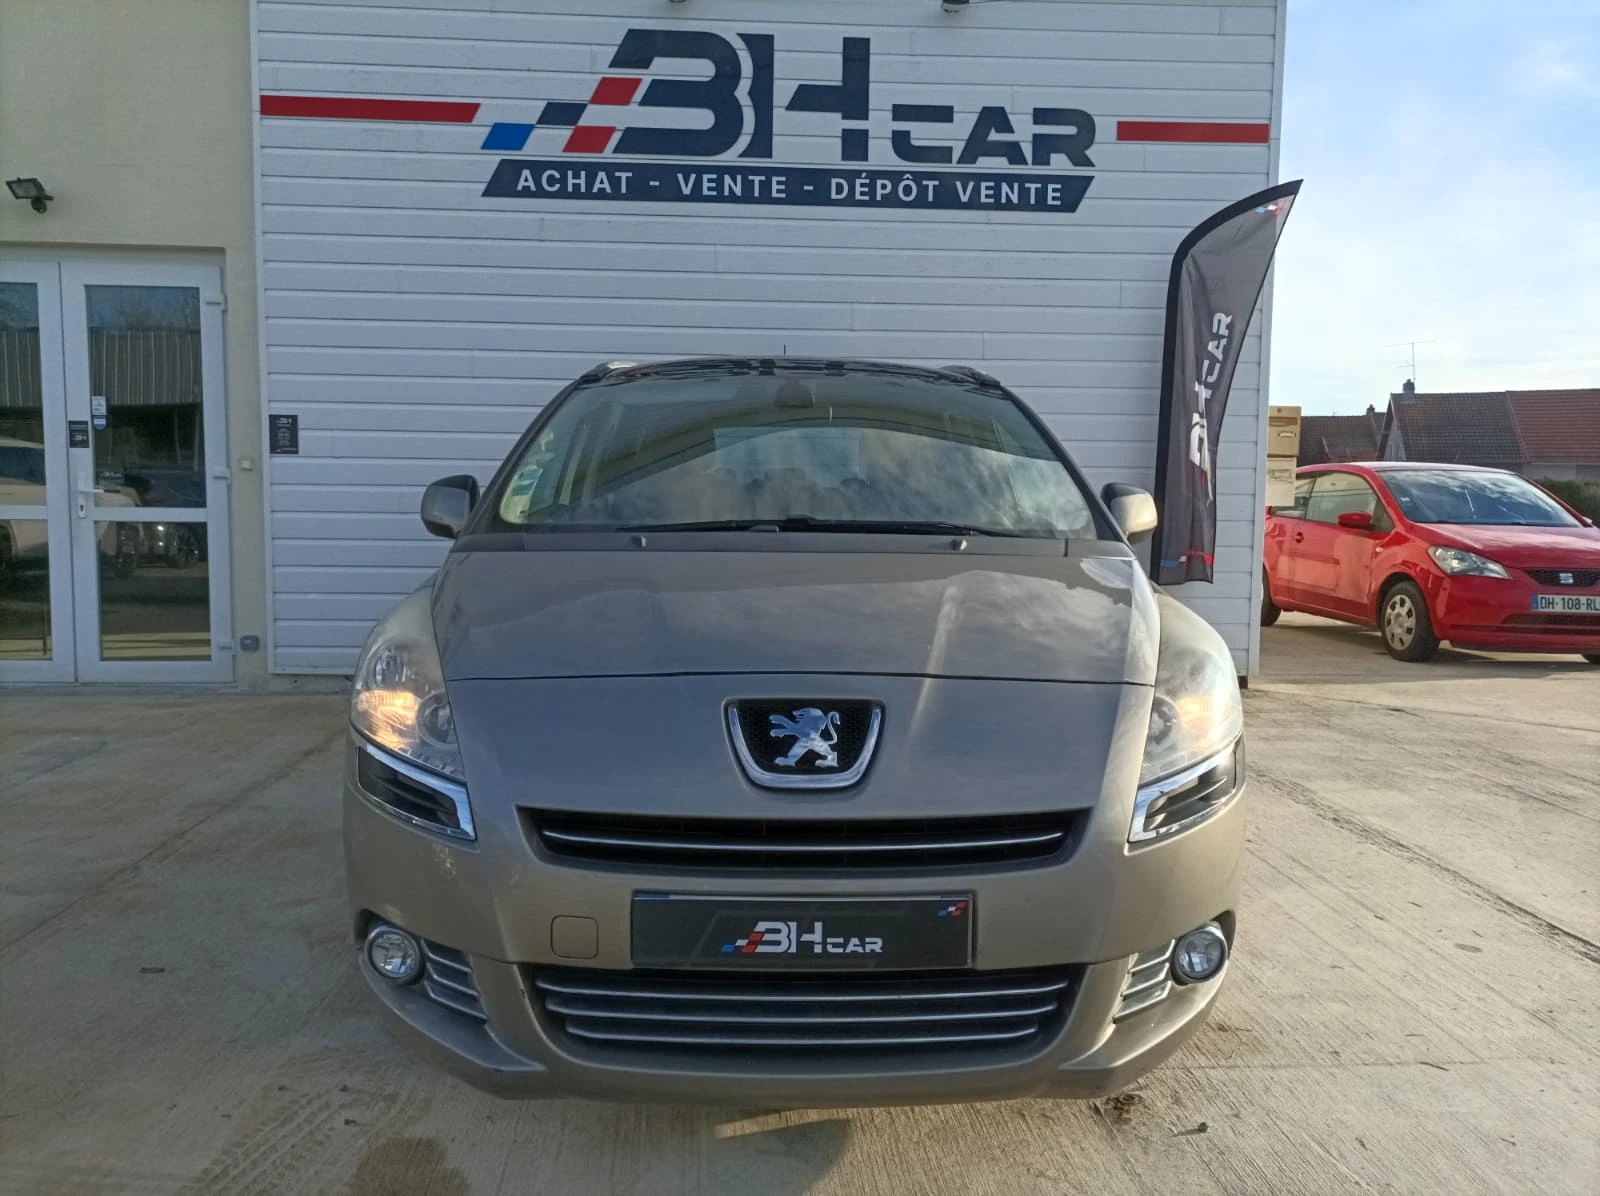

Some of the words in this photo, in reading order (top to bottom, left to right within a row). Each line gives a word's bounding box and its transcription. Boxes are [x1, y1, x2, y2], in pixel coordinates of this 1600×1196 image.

[516, 168, 633, 194] ACHAT
[677, 172, 787, 198] VENTE
[830, 172, 940, 203] DÉPÔT
[955, 180, 1062, 206] VENTE
[1540, 596, 1600, 611] DH-108-RL
